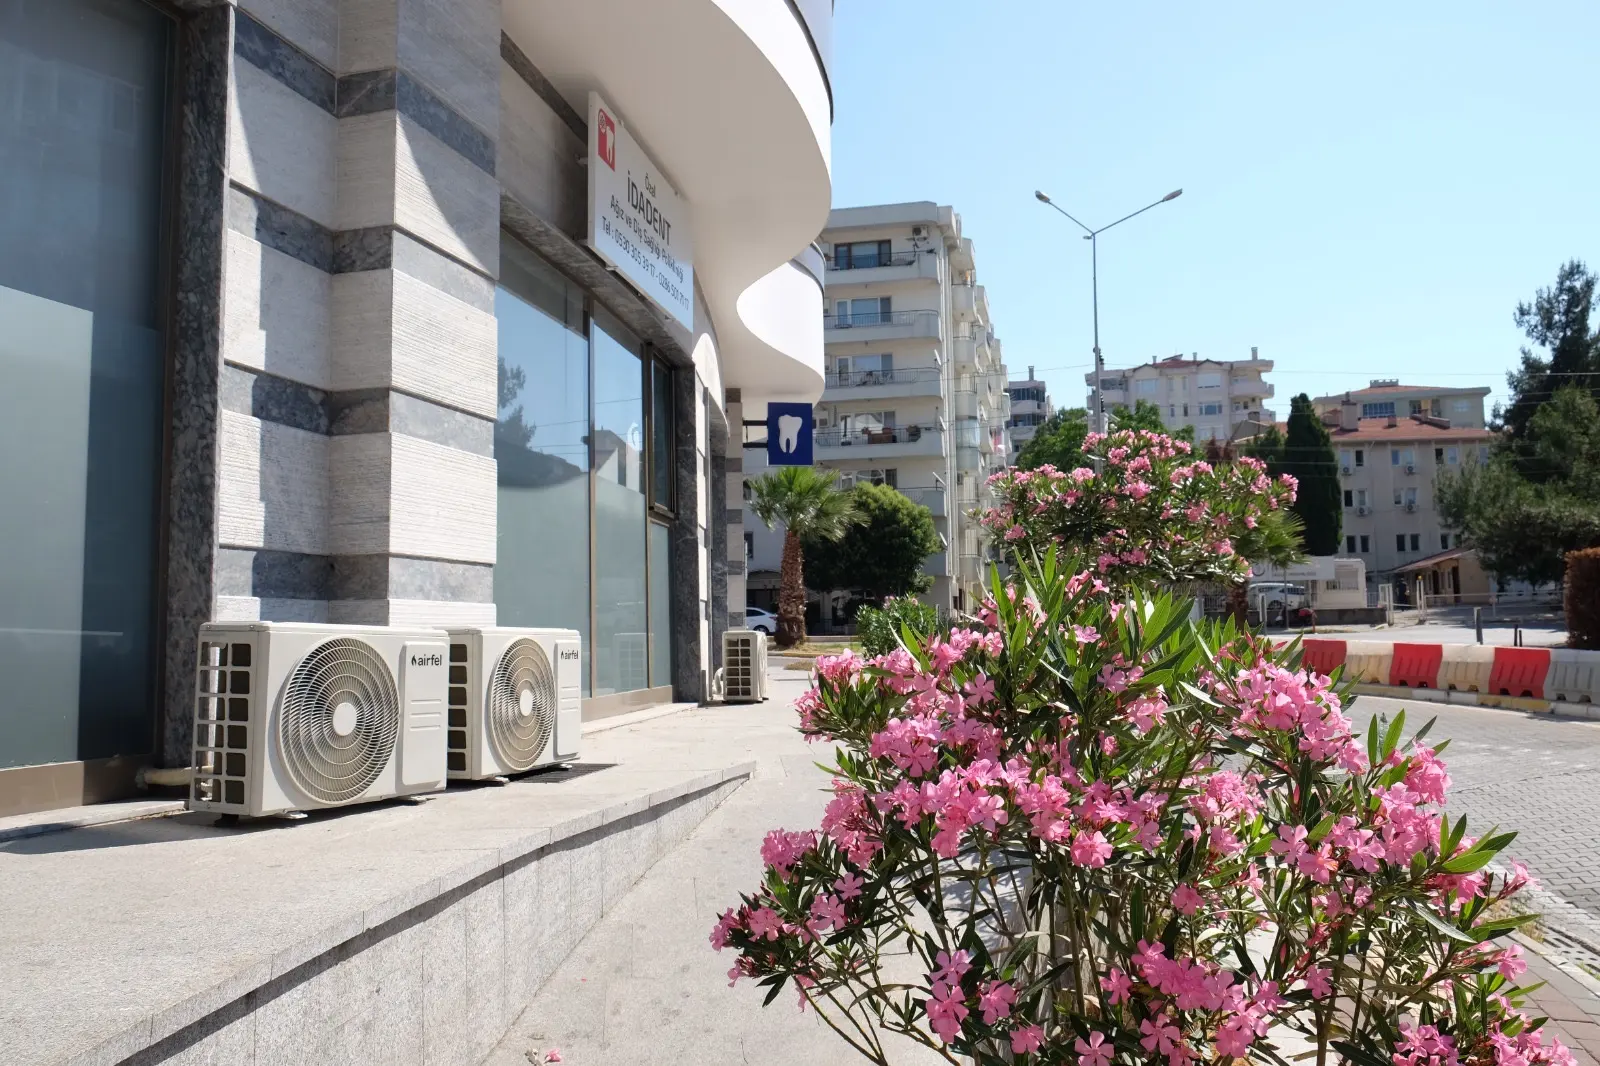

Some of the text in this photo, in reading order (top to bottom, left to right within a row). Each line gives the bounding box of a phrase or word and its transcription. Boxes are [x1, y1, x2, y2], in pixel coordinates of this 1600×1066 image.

[627, 169, 671, 246] İDADENT
[625, 214, 632, 229] ve
[633, 217, 643, 243] Diş
[417, 654, 442, 667] airfel
[564, 650, 579, 660] airfel
